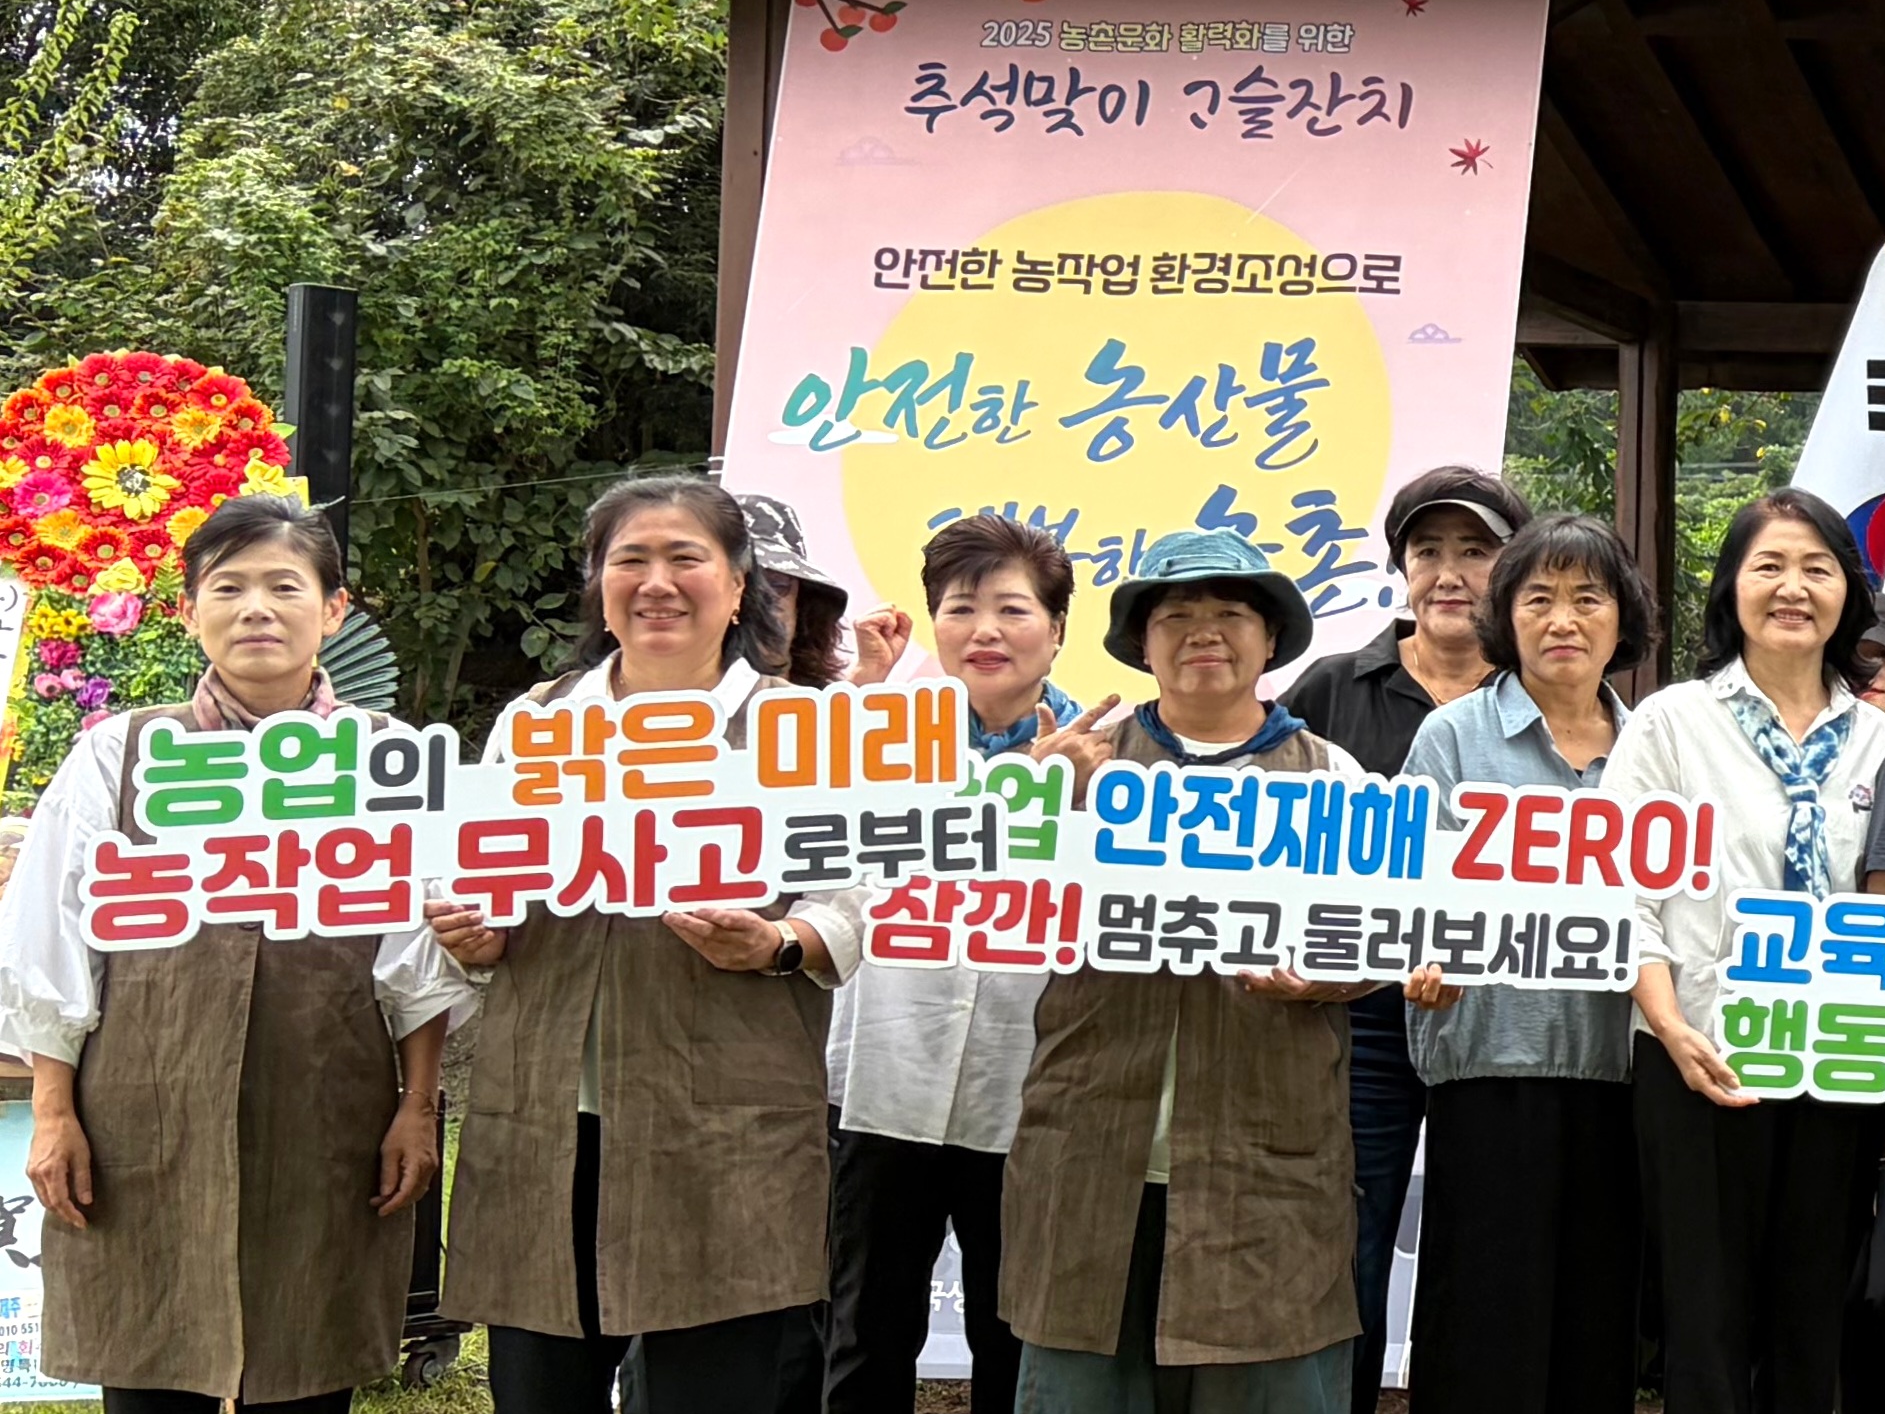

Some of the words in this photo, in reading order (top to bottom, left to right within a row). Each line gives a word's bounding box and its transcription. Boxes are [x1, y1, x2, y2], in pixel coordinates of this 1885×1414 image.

[982, 20, 1051, 48] 2025
[1059, 21, 1172, 53] 농촌문화
[1180, 22, 1291, 54] 활력화를
[1299, 23, 1355, 54] 위한
[904, 59, 1149, 138] 추석맞이
[873, 246, 1003, 291] 안전한
[1012, 250, 1141, 295] 농작업
[1150, 252, 1402, 296] 환경조성으로
[783, 347, 1038, 452] 안전한
[1059, 337, 1331, 470] 농산물
[142, 716, 445, 826] 농업의
[511, 700, 719, 806] 밝은
[758, 686, 957, 788] 미래
[90, 823, 412, 941] 농작업
[453, 806, 996, 918] 무사고로부터
[1095, 770, 1427, 879] 안전재해
[1452, 790, 1716, 889] ZERO!
[869, 877, 1083, 965] 잠깐!
[1098, 894, 1279, 968] 멈추고
[1304, 904, 1629, 981] 둘러보세요!
